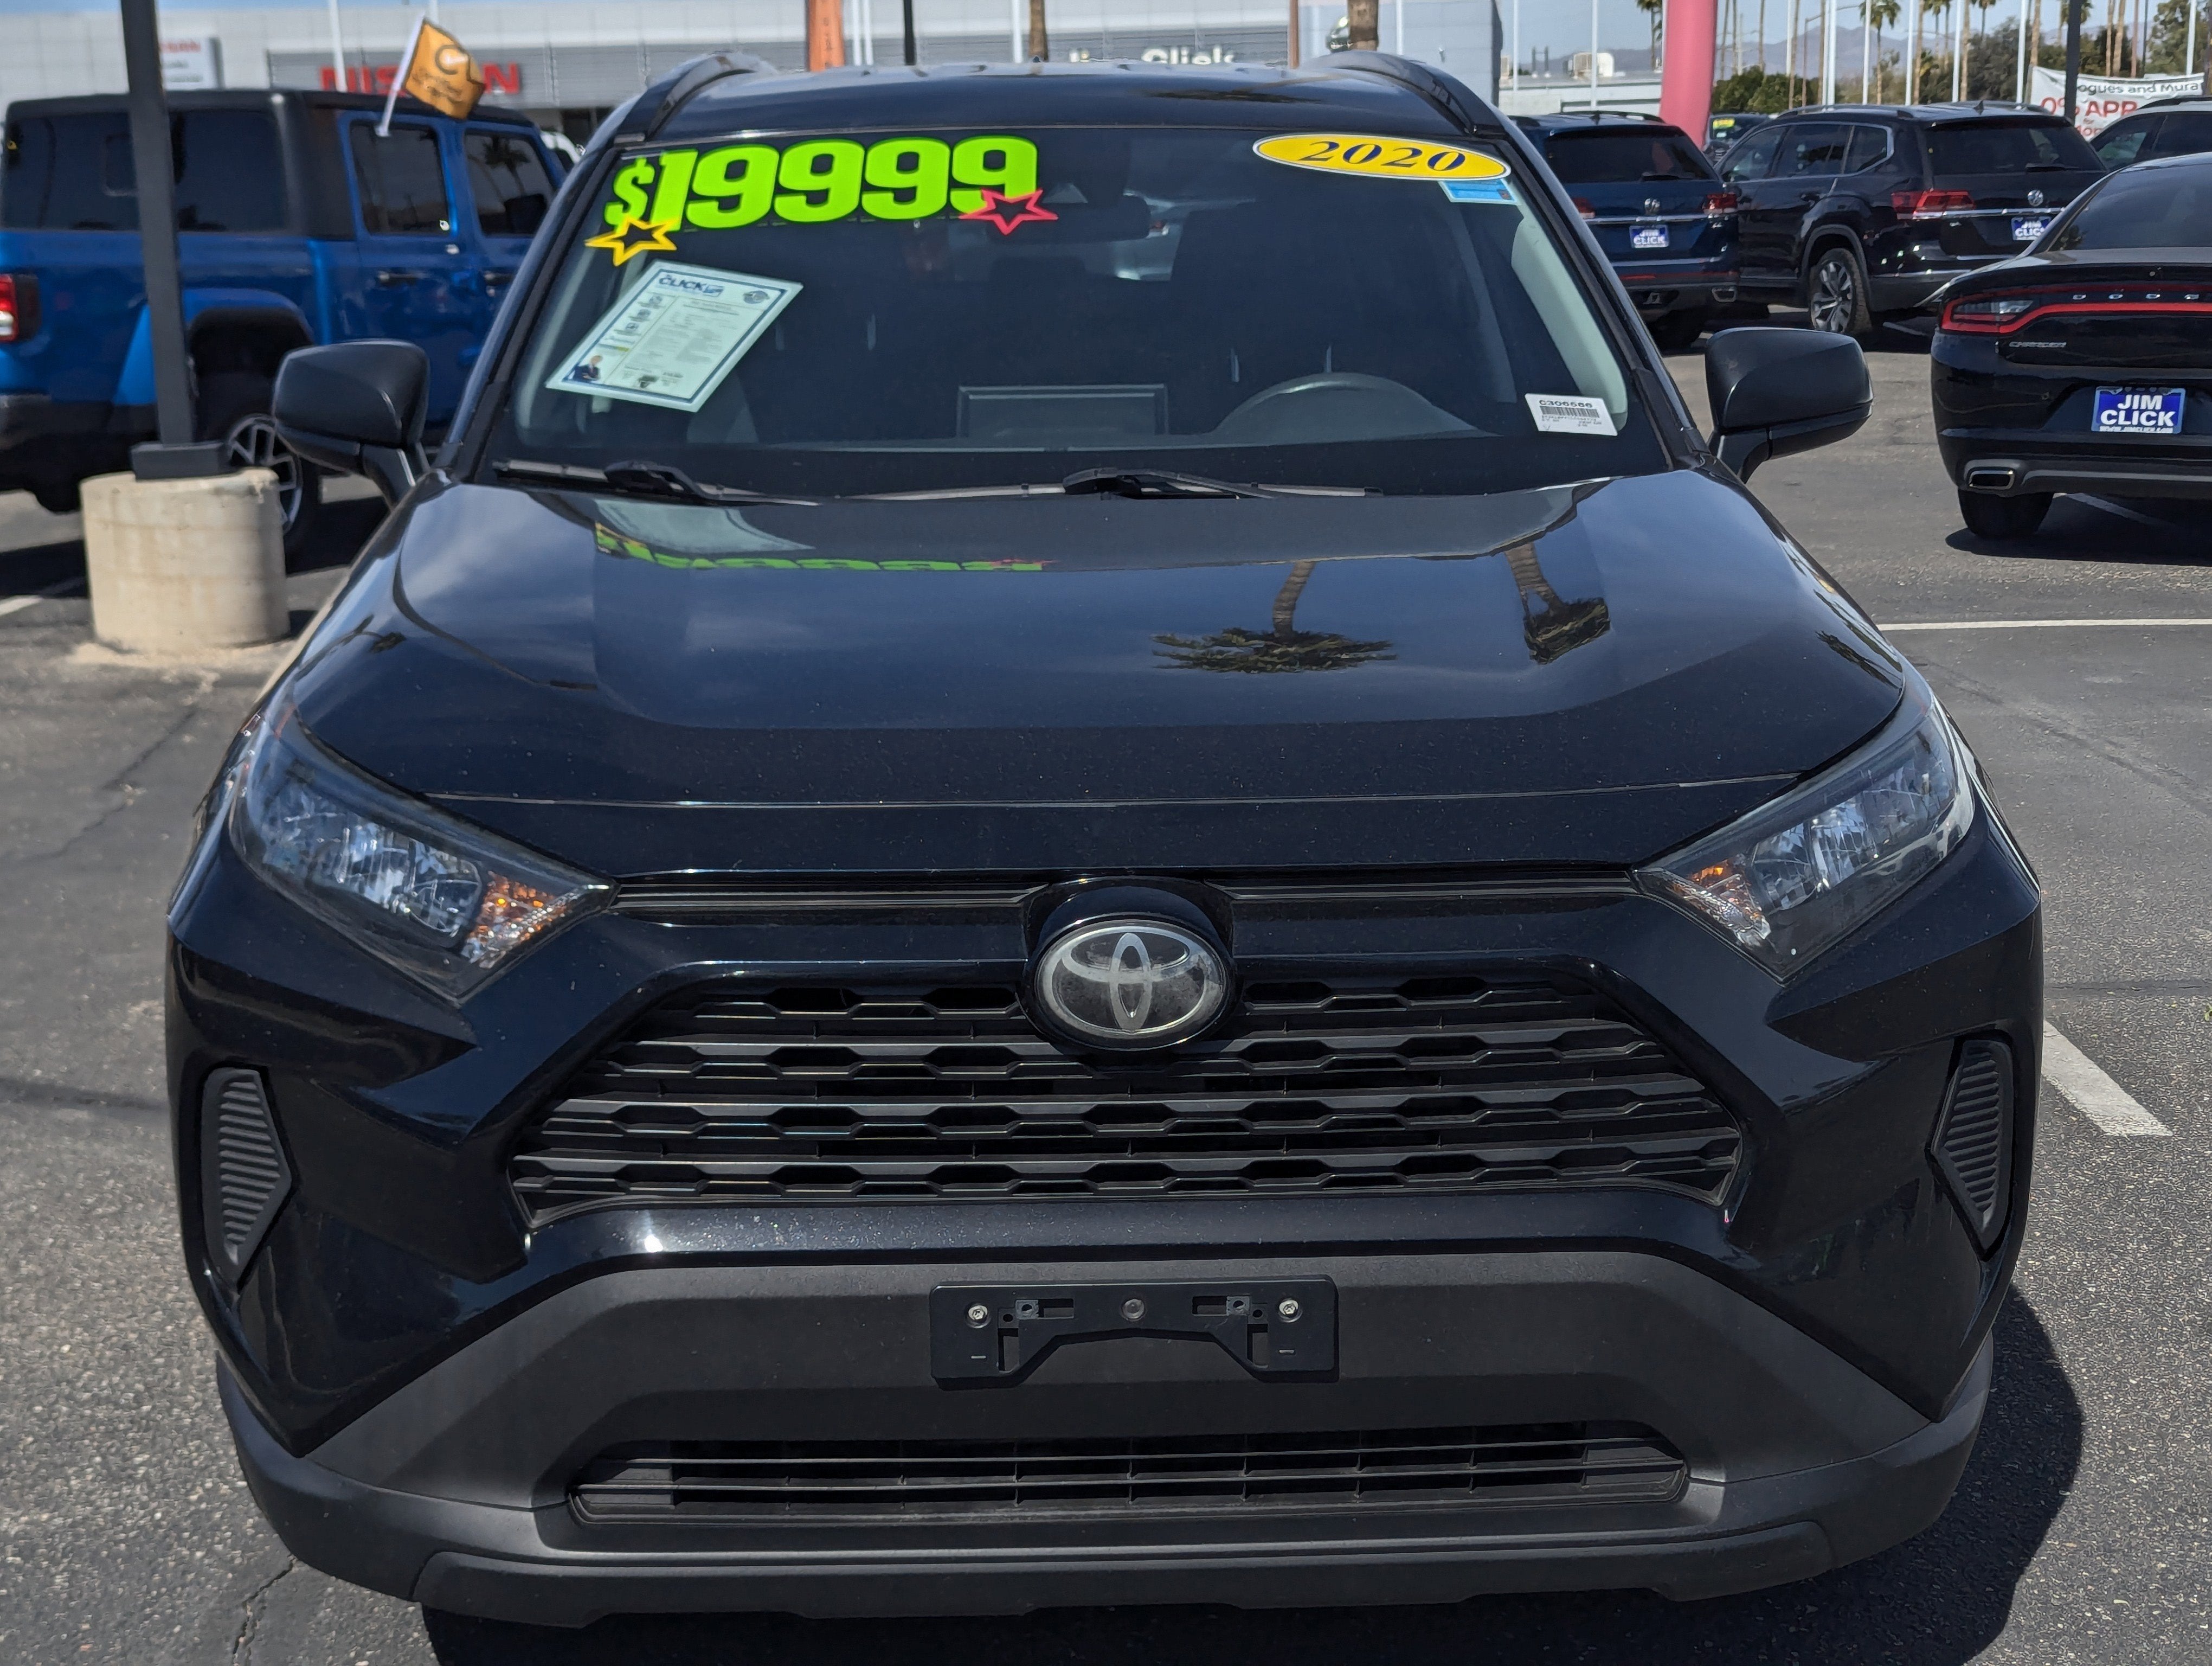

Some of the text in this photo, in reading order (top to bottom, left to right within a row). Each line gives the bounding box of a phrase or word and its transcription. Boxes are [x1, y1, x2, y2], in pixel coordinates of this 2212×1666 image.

[2077, 84, 2124, 95] ogues
[2128, 82, 2156, 93] and
[1297, 140, 1465, 171] 2020
[605, 136, 1038, 232] $19999
[2118, 394, 2163, 410] JIM
[2100, 409, 2176, 427] CLICK
